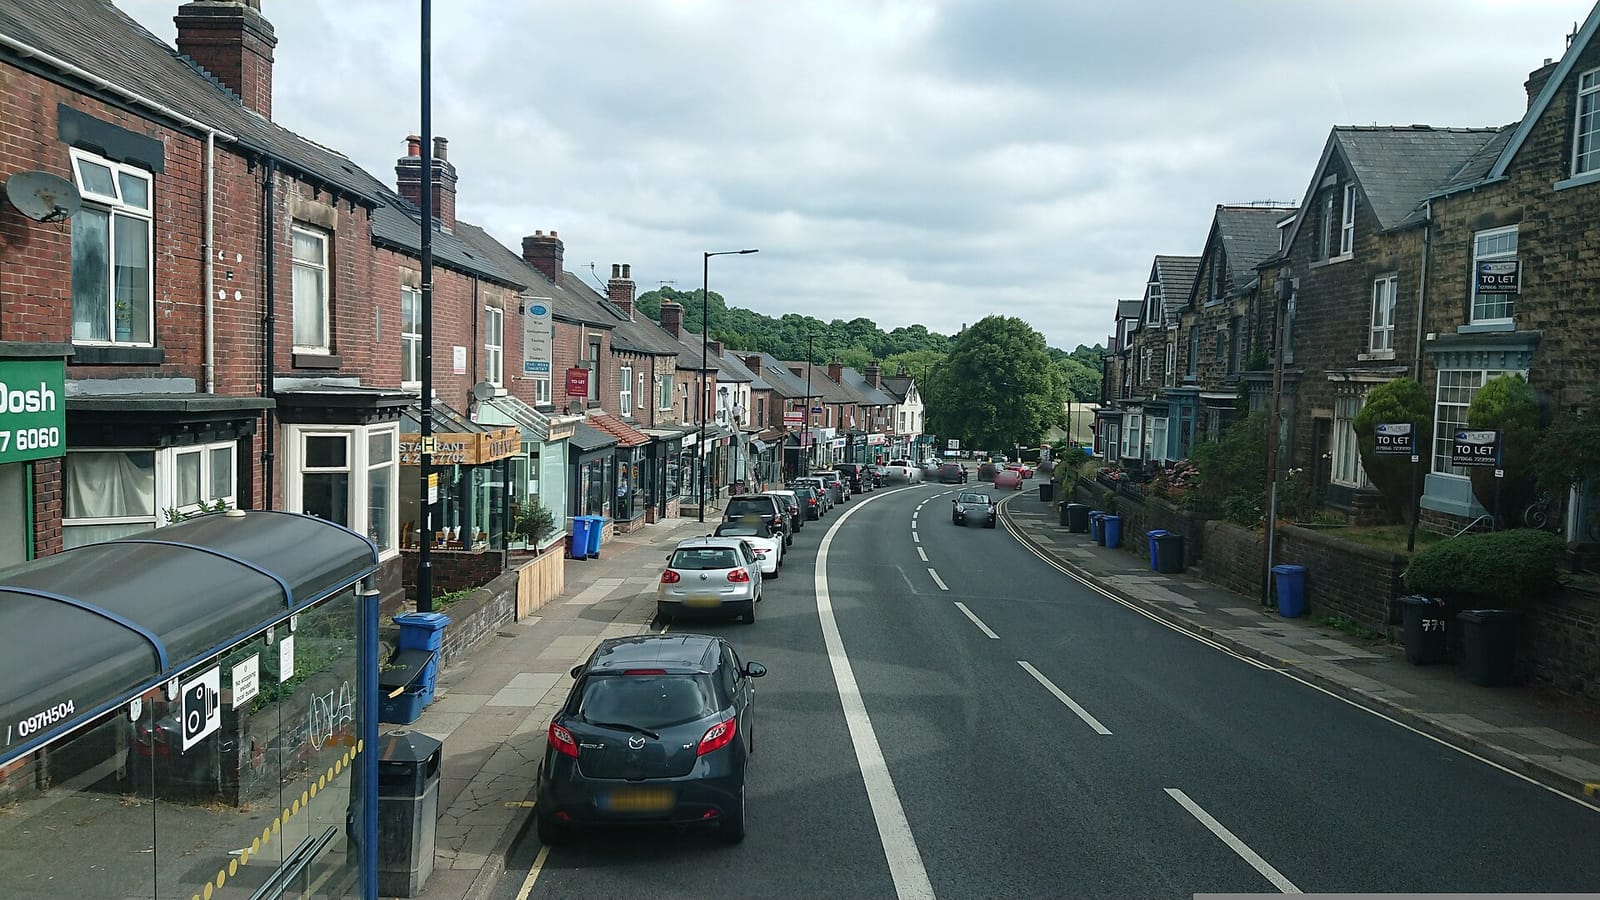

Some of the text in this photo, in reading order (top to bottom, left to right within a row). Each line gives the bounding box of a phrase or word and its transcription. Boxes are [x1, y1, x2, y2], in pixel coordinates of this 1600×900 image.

[1481, 275, 1515, 283] TO LET
[16, 427, 59, 450] 6060
[425, 437, 435, 452] H
[1377, 436, 1410, 444] TO LET
[1455, 445, 1494, 454] TO LET
[1422, 619, 1446, 632] 779
[19, 699, 75, 736] 097H504
